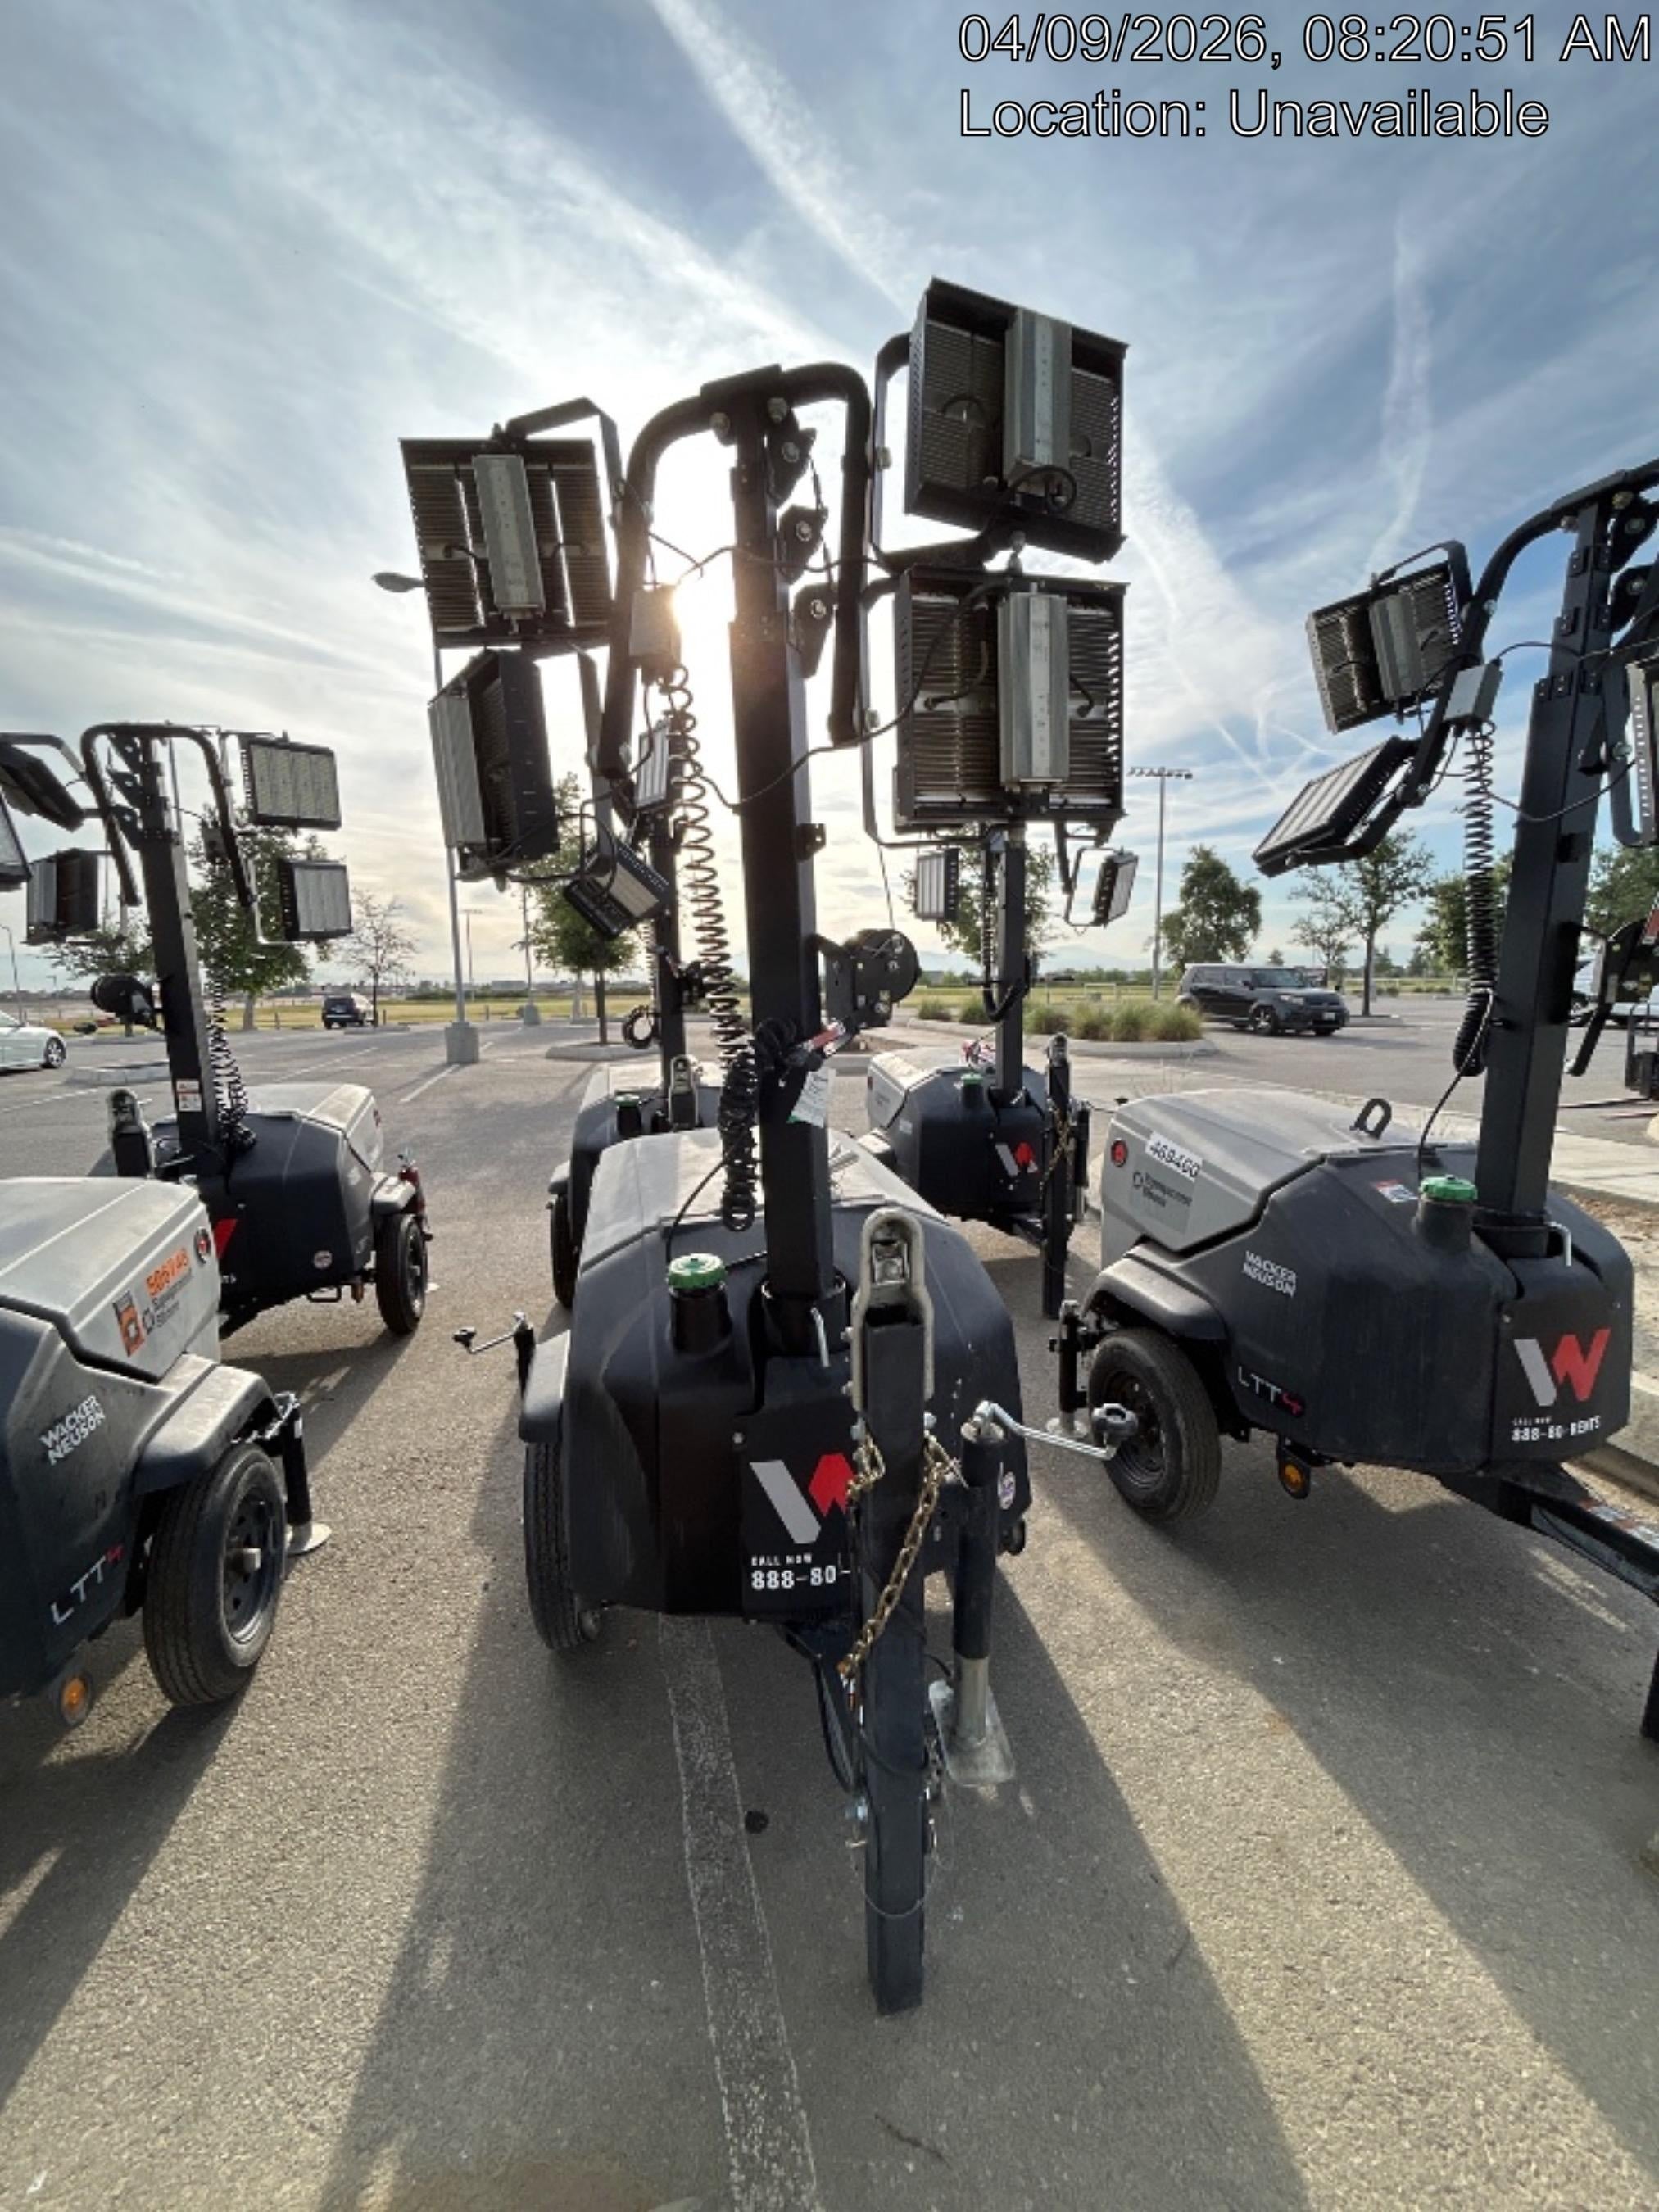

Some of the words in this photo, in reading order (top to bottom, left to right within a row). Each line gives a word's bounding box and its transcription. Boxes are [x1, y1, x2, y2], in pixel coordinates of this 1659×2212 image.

[1242, 1262, 1297, 1298] NEUSON
[1244, 1250, 1297, 1284] WACKER
[41, 1395, 99, 1448] WACKER
[48, 1408, 107, 1466] NEUSON
[751, 1565, 852, 1590] 888-80-
